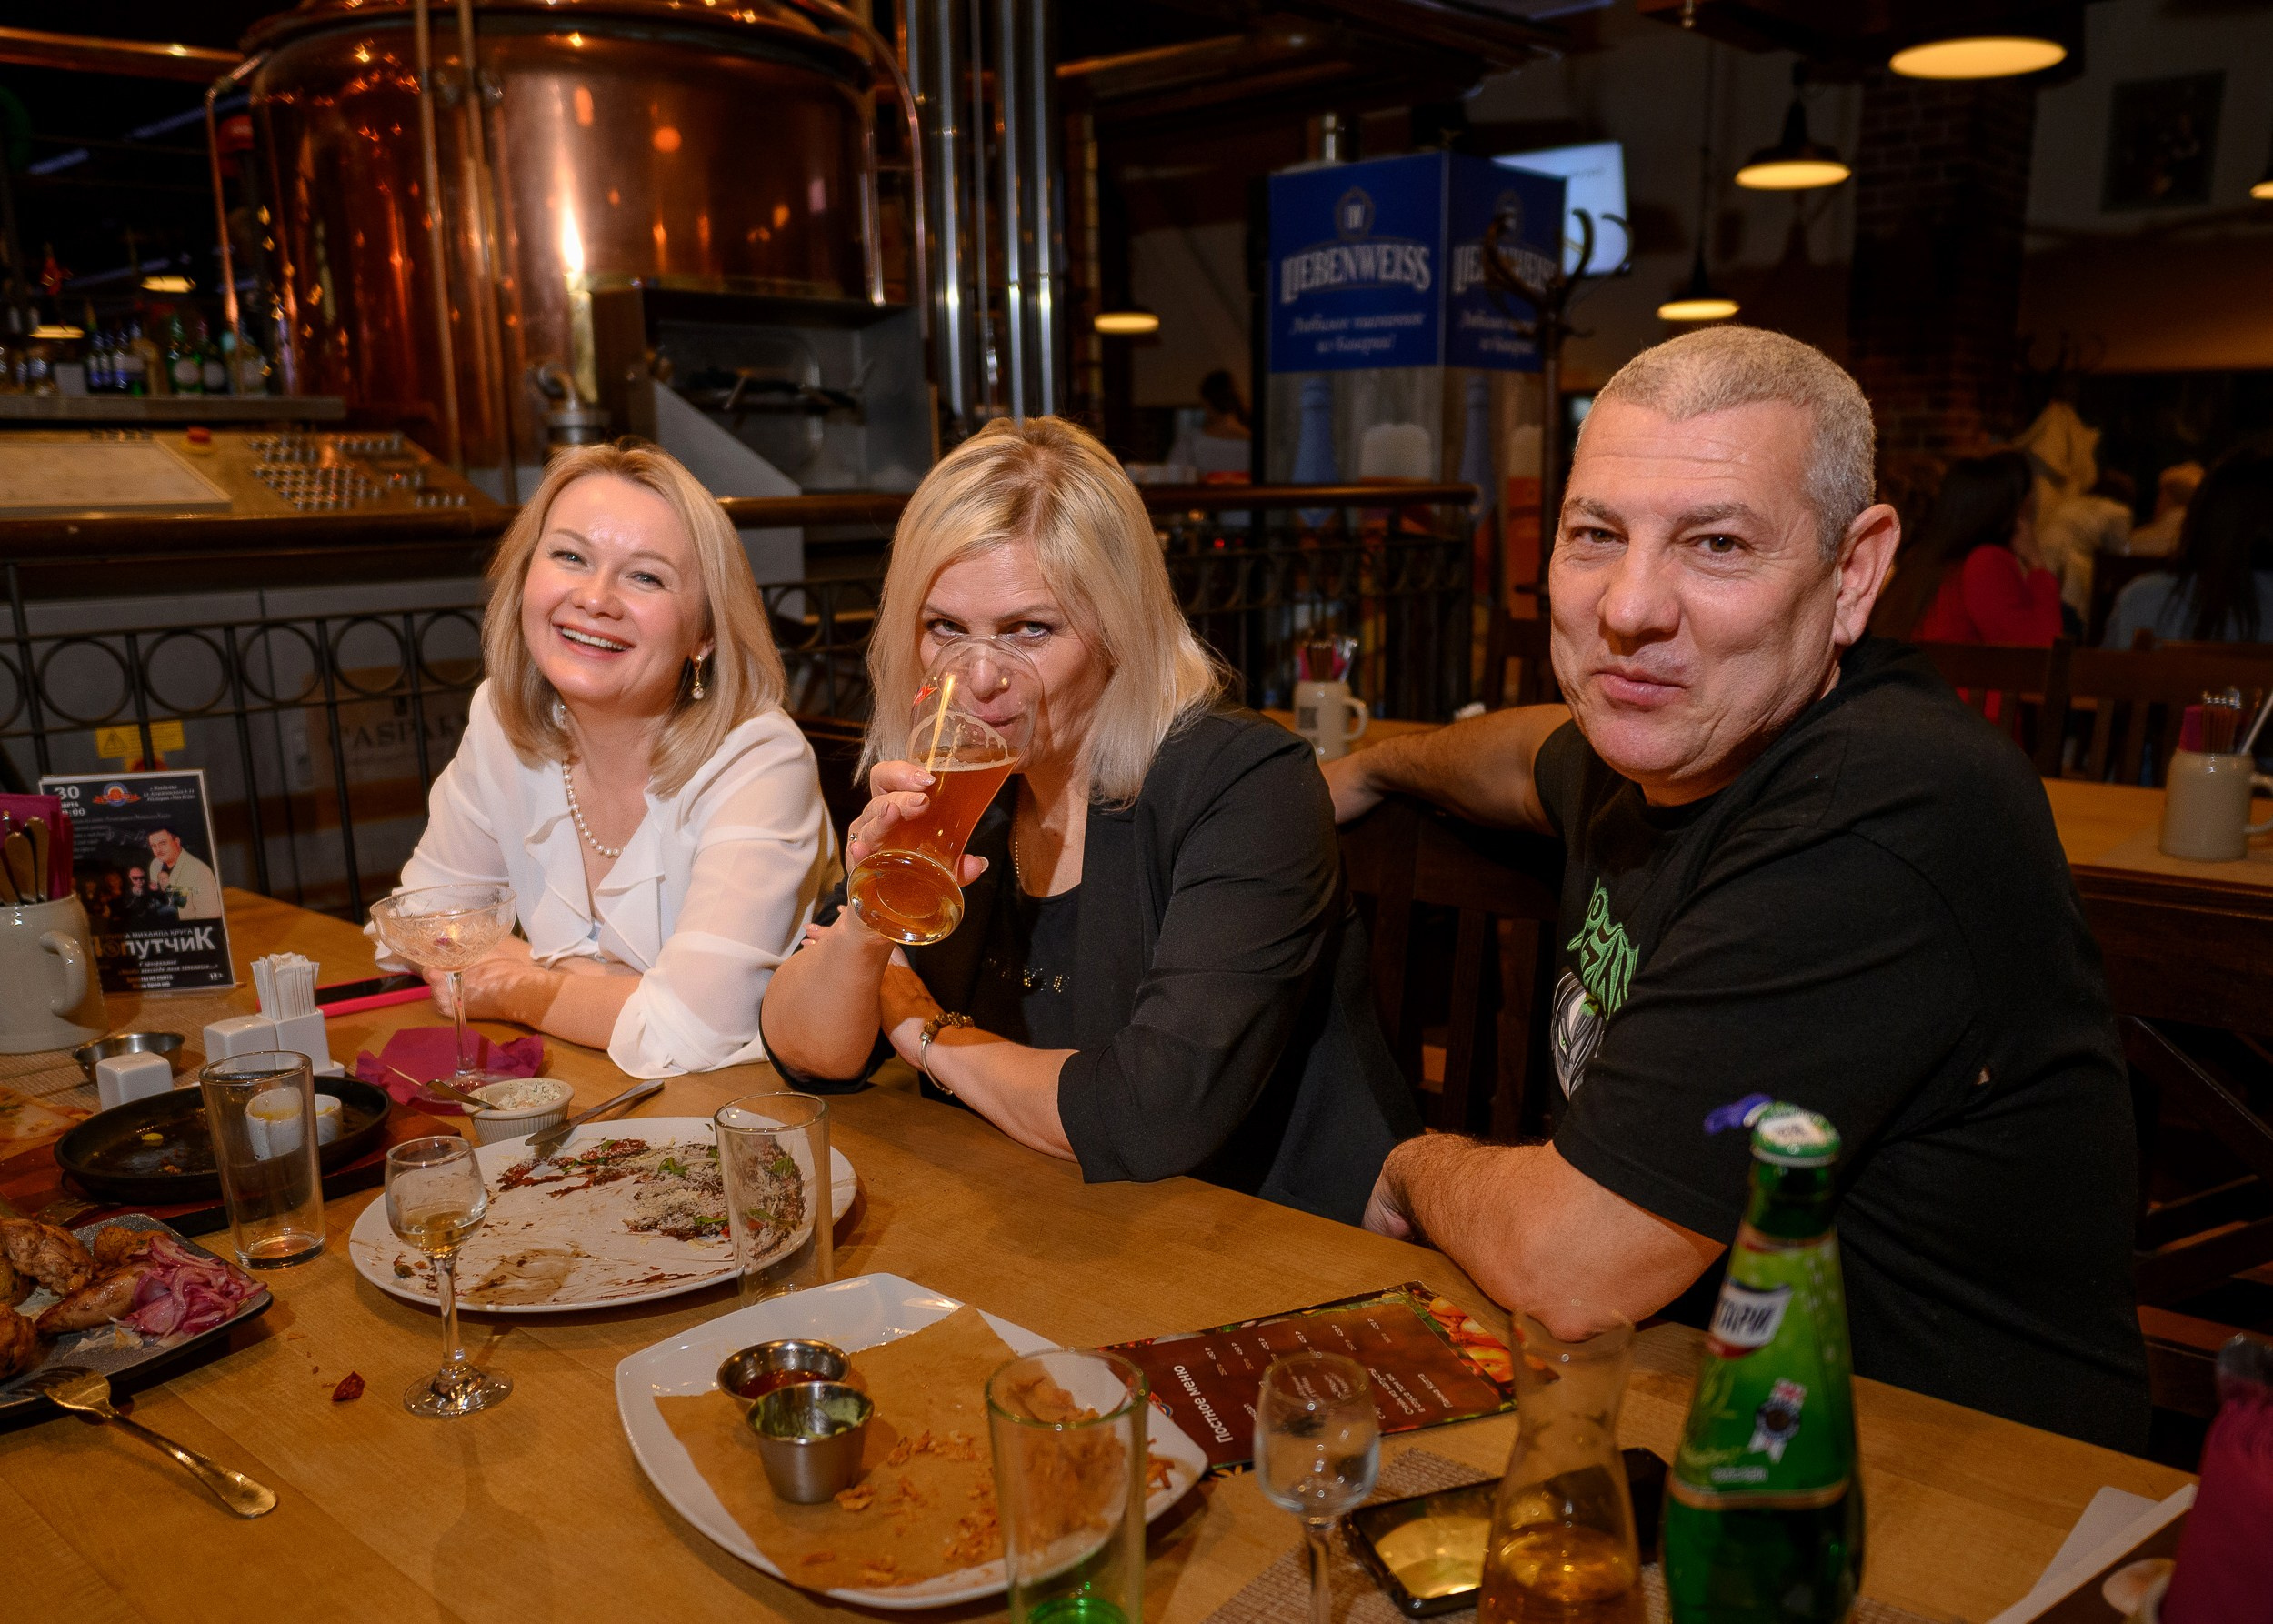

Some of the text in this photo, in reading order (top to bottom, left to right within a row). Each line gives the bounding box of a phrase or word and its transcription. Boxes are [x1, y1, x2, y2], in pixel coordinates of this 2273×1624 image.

[1279, 244, 1432, 306] LIEBENWEISS
[53, 785, 80, 800] 30
[61, 807, 85, 817] 9:00
[209, 972, 224, 981] 12+
[1173, 1365, 1234, 1443] Постное меню
